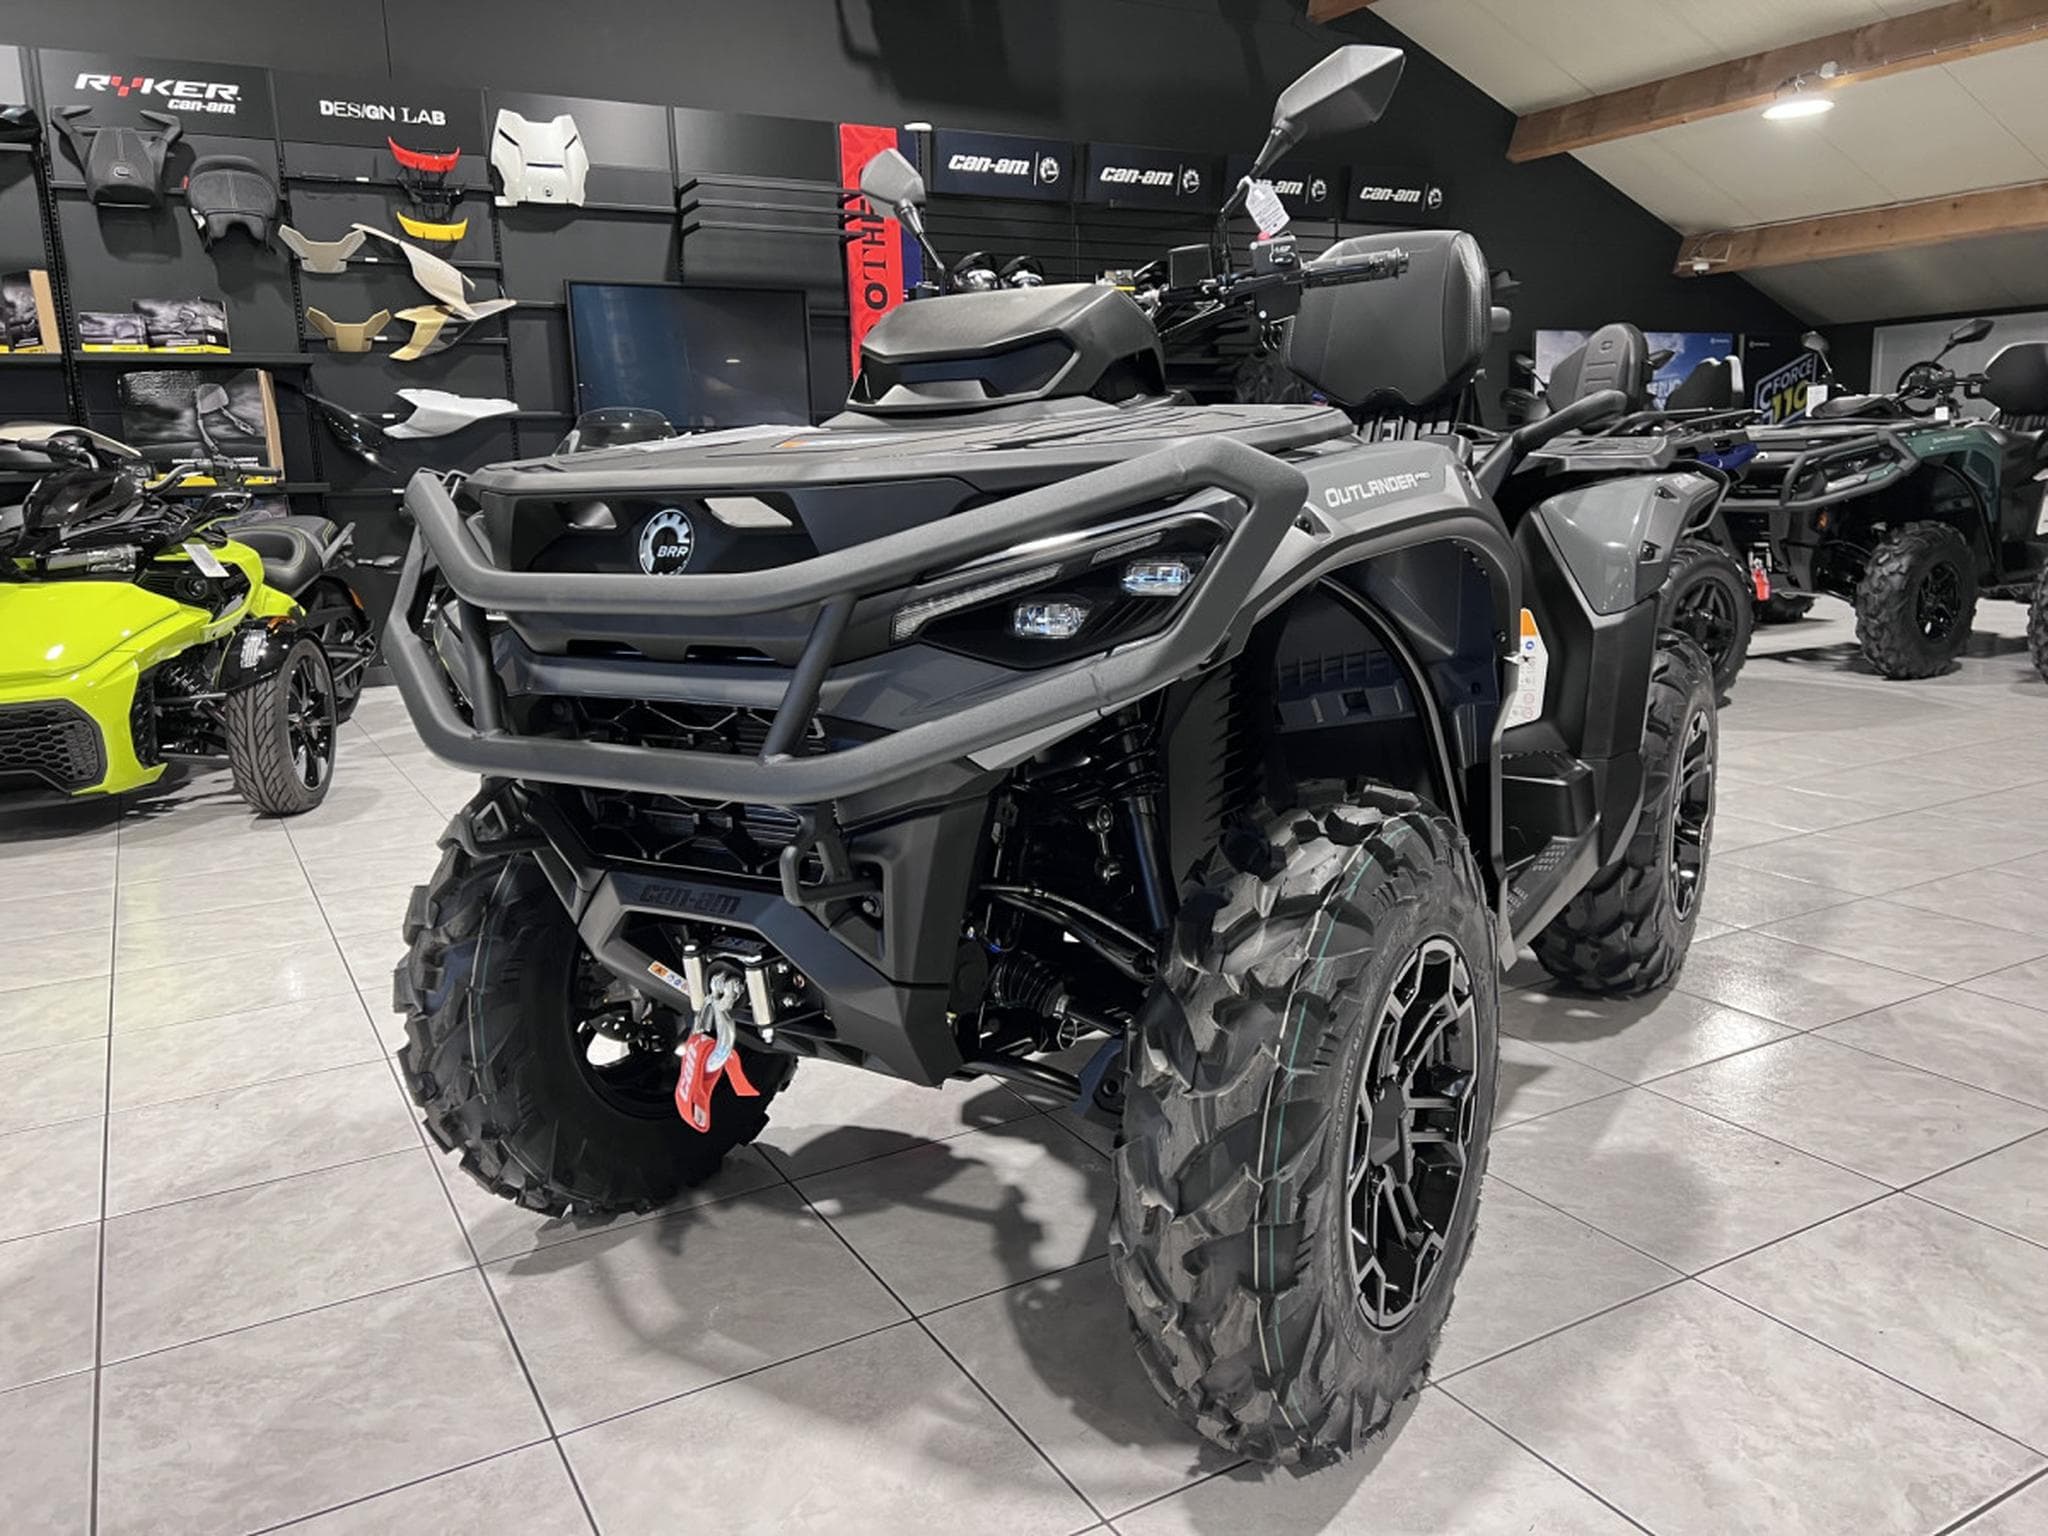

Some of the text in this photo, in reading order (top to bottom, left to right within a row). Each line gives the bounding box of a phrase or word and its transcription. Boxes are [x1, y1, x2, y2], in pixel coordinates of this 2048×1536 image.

[74, 73, 240, 101] RYKER
[167, 98, 237, 115] can-am
[319, 99, 447, 126] DESIGN LAB
[948, 153, 1030, 176] can-am
[1099, 165, 1174, 187] can-am
[1359, 185, 1421, 203] can-am
[1759, 357, 1814, 412] CFORCE
[1771, 380, 1808, 424] 110
[1324, 473, 1418, 508] OUTLANDER
[656, 544, 689, 558] BRP
[640, 883, 742, 915] can-am
